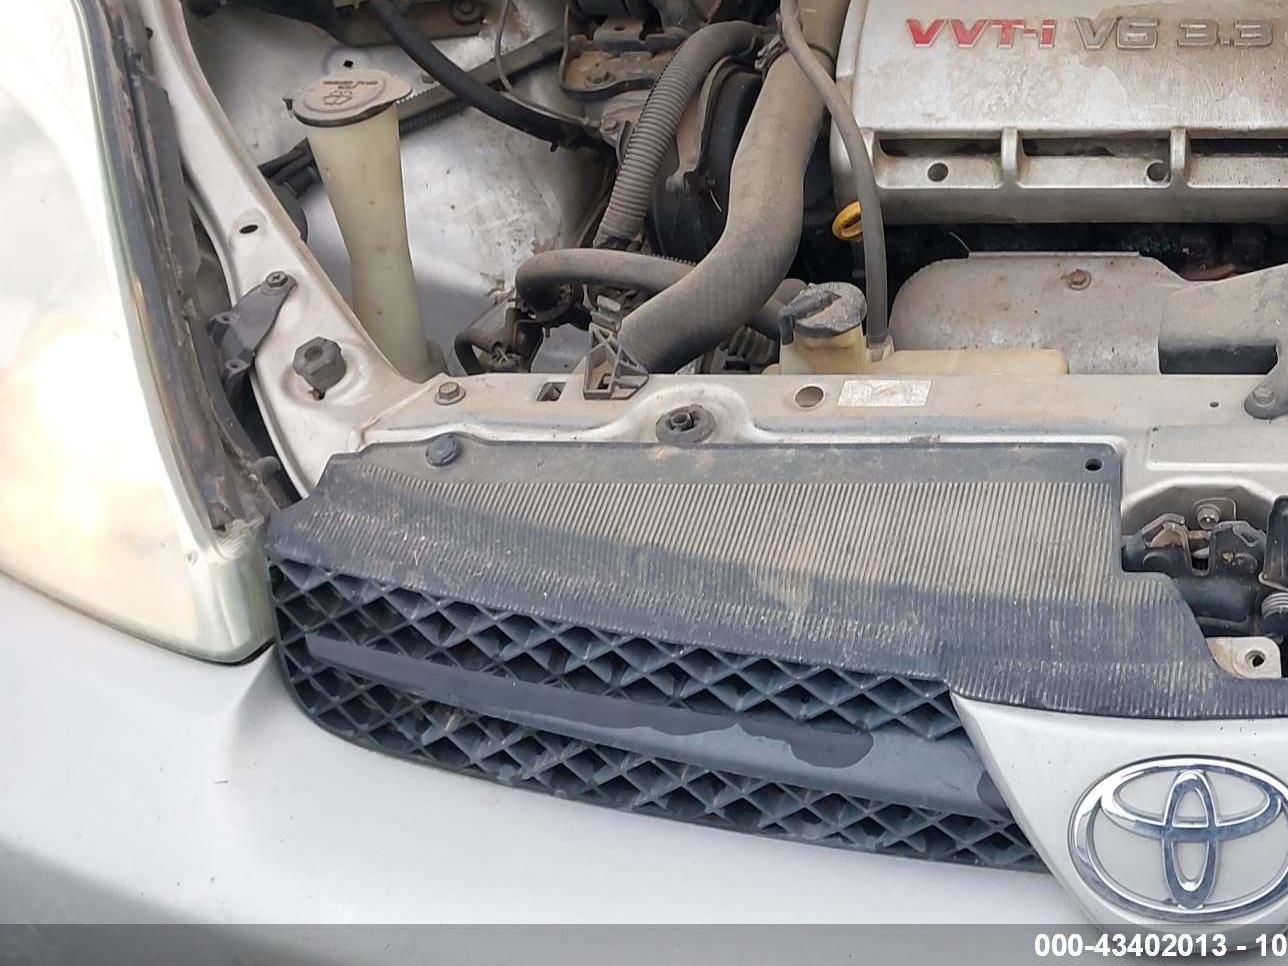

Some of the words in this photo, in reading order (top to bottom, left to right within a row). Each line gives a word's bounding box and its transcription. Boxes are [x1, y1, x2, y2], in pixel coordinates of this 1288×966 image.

[905, 18, 1057, 49] VVT-i
[1073, 17, 1160, 50] V6
[1177, 18, 1275, 48] 3.3
